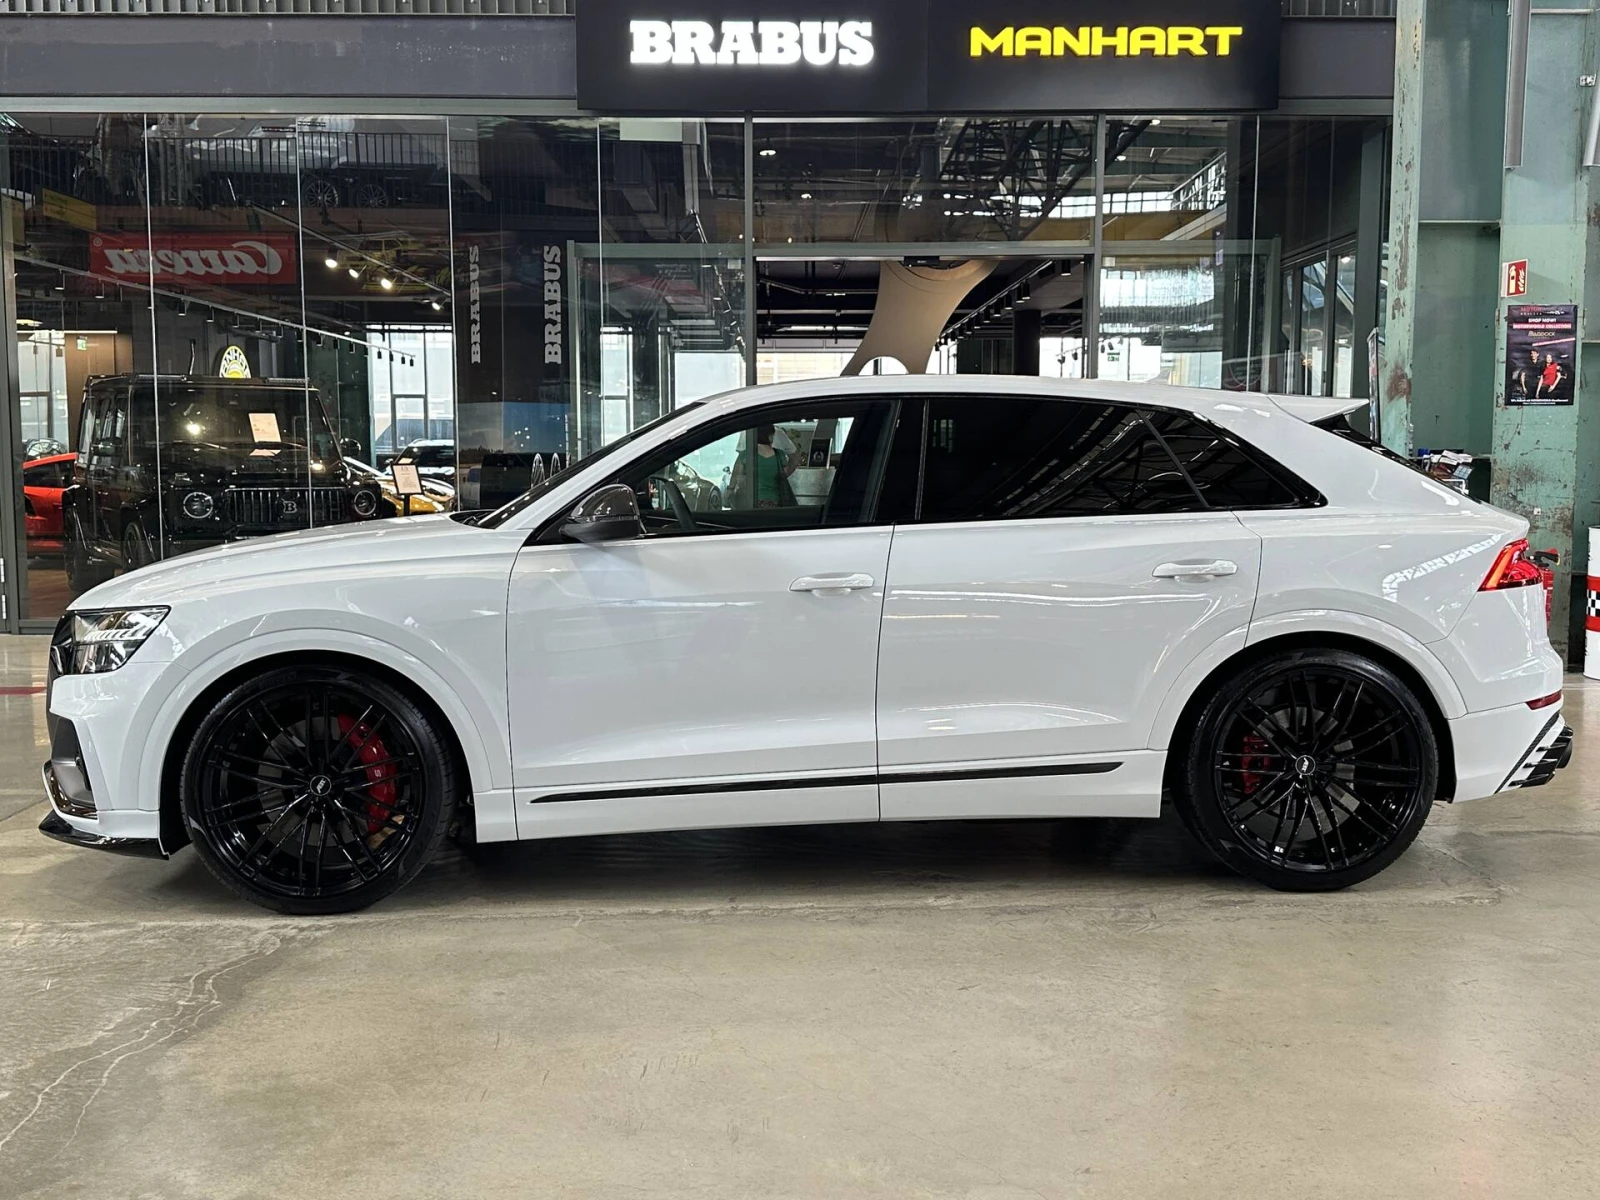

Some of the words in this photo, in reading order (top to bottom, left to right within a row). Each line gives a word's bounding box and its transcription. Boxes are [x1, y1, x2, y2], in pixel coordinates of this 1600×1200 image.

[629, 20, 874, 66] BRABUS
[969, 26, 1243, 57] MANHART
[469, 245, 481, 364] BRABUS
[543, 245, 561, 364] BRABUS
